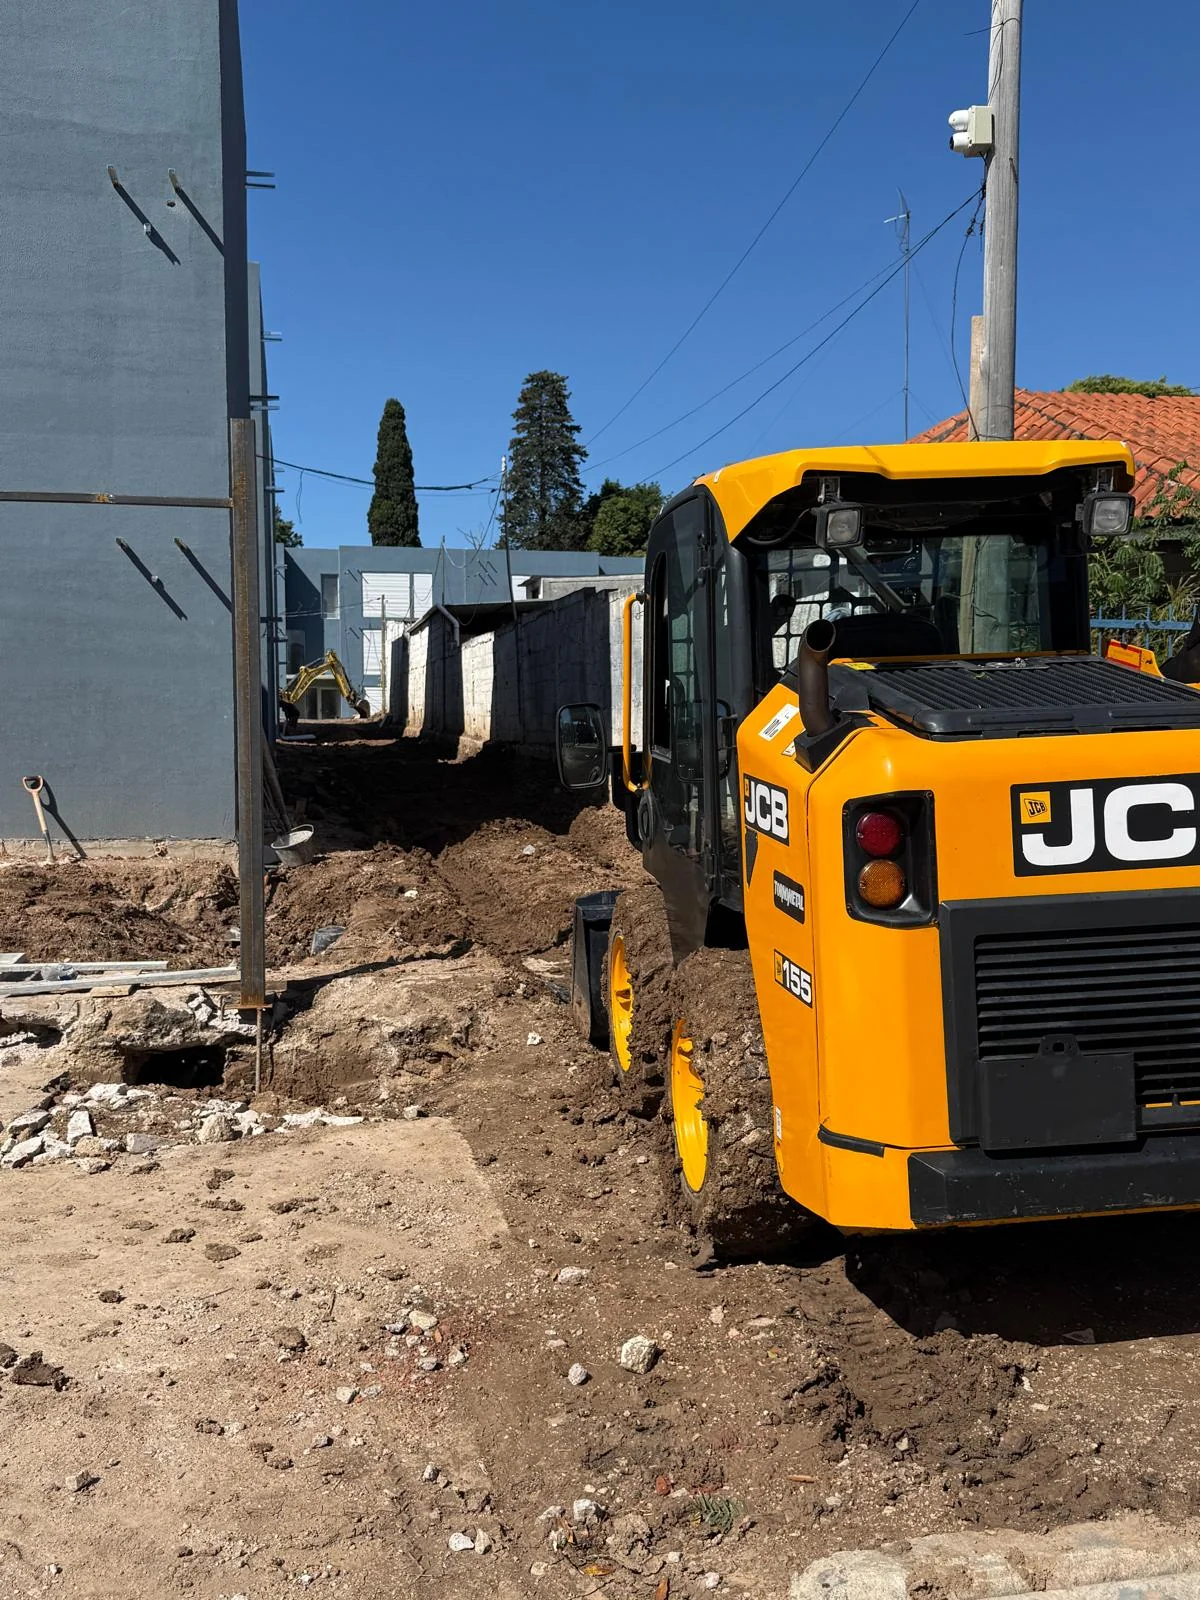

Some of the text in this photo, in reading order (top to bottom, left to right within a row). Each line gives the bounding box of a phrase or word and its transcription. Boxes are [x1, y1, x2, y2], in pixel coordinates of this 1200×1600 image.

[745, 781, 789, 839] JCB
[1028, 801, 1046, 816] JCB
[783, 960, 812, 1004] 155
